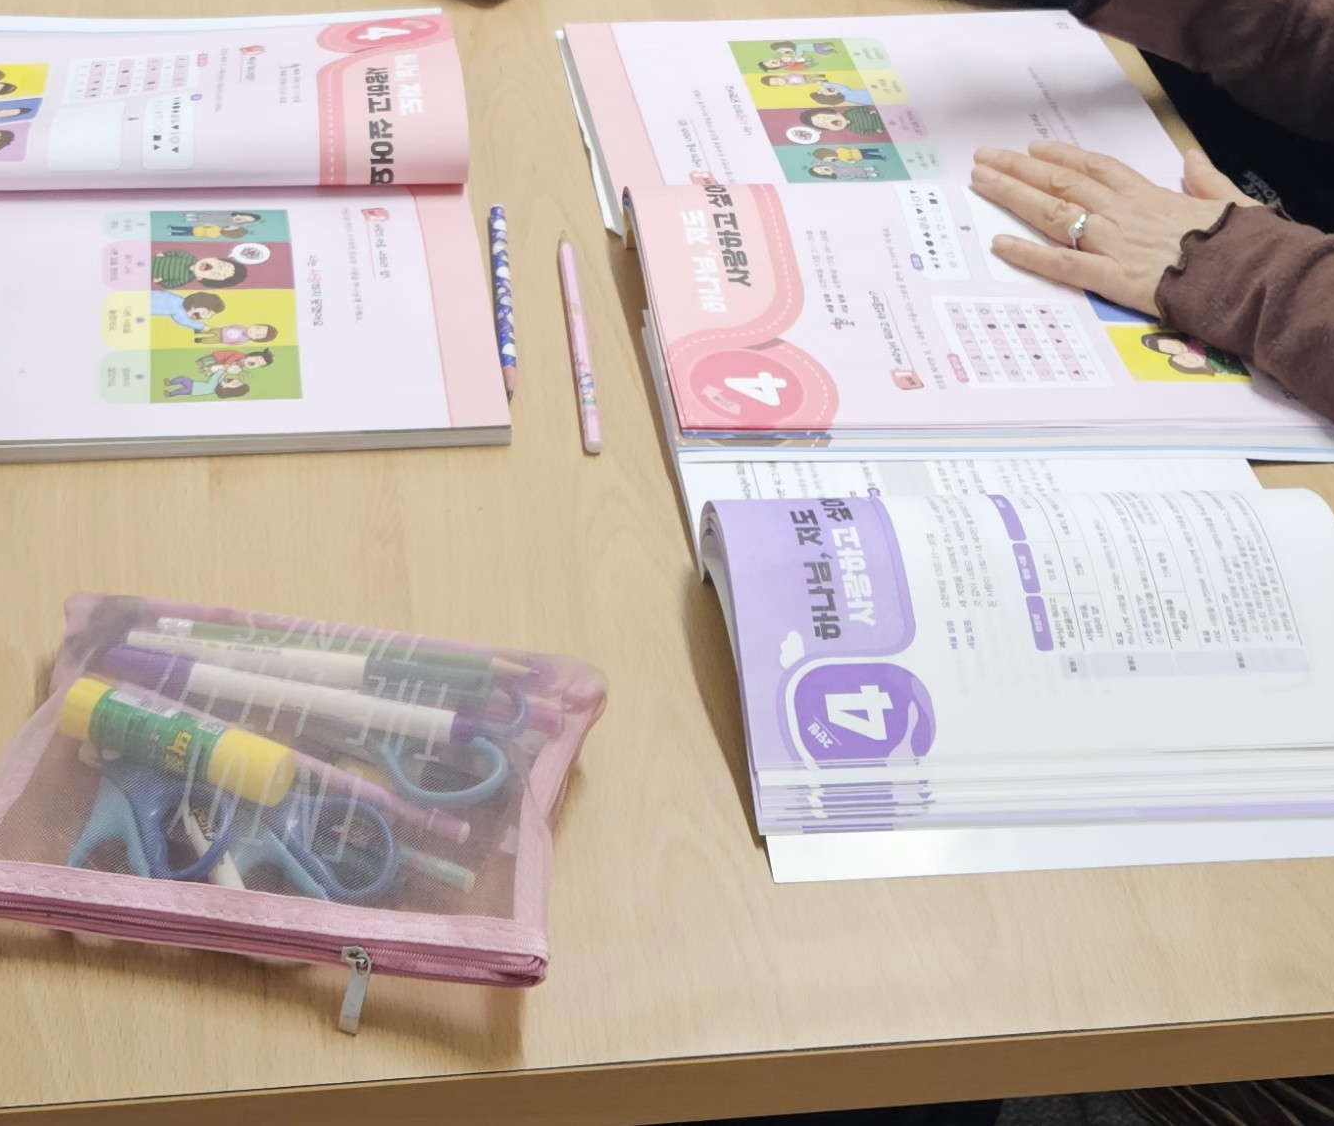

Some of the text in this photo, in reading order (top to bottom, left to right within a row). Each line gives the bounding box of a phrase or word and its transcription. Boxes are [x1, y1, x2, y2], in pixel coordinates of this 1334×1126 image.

[365, 67, 394, 185] 사랑하고 싶어요
[681, 209, 727, 313] 하나님, 저도
[713, 212, 752, 287] 사랑하고
[724, 372, 787, 406] 4
[789, 509, 842, 640] 하나님, 저도
[831, 526, 876, 626] 사랑하고
[807, 722, 834, 749] 2단원
[824, 684, 894, 741] 4
